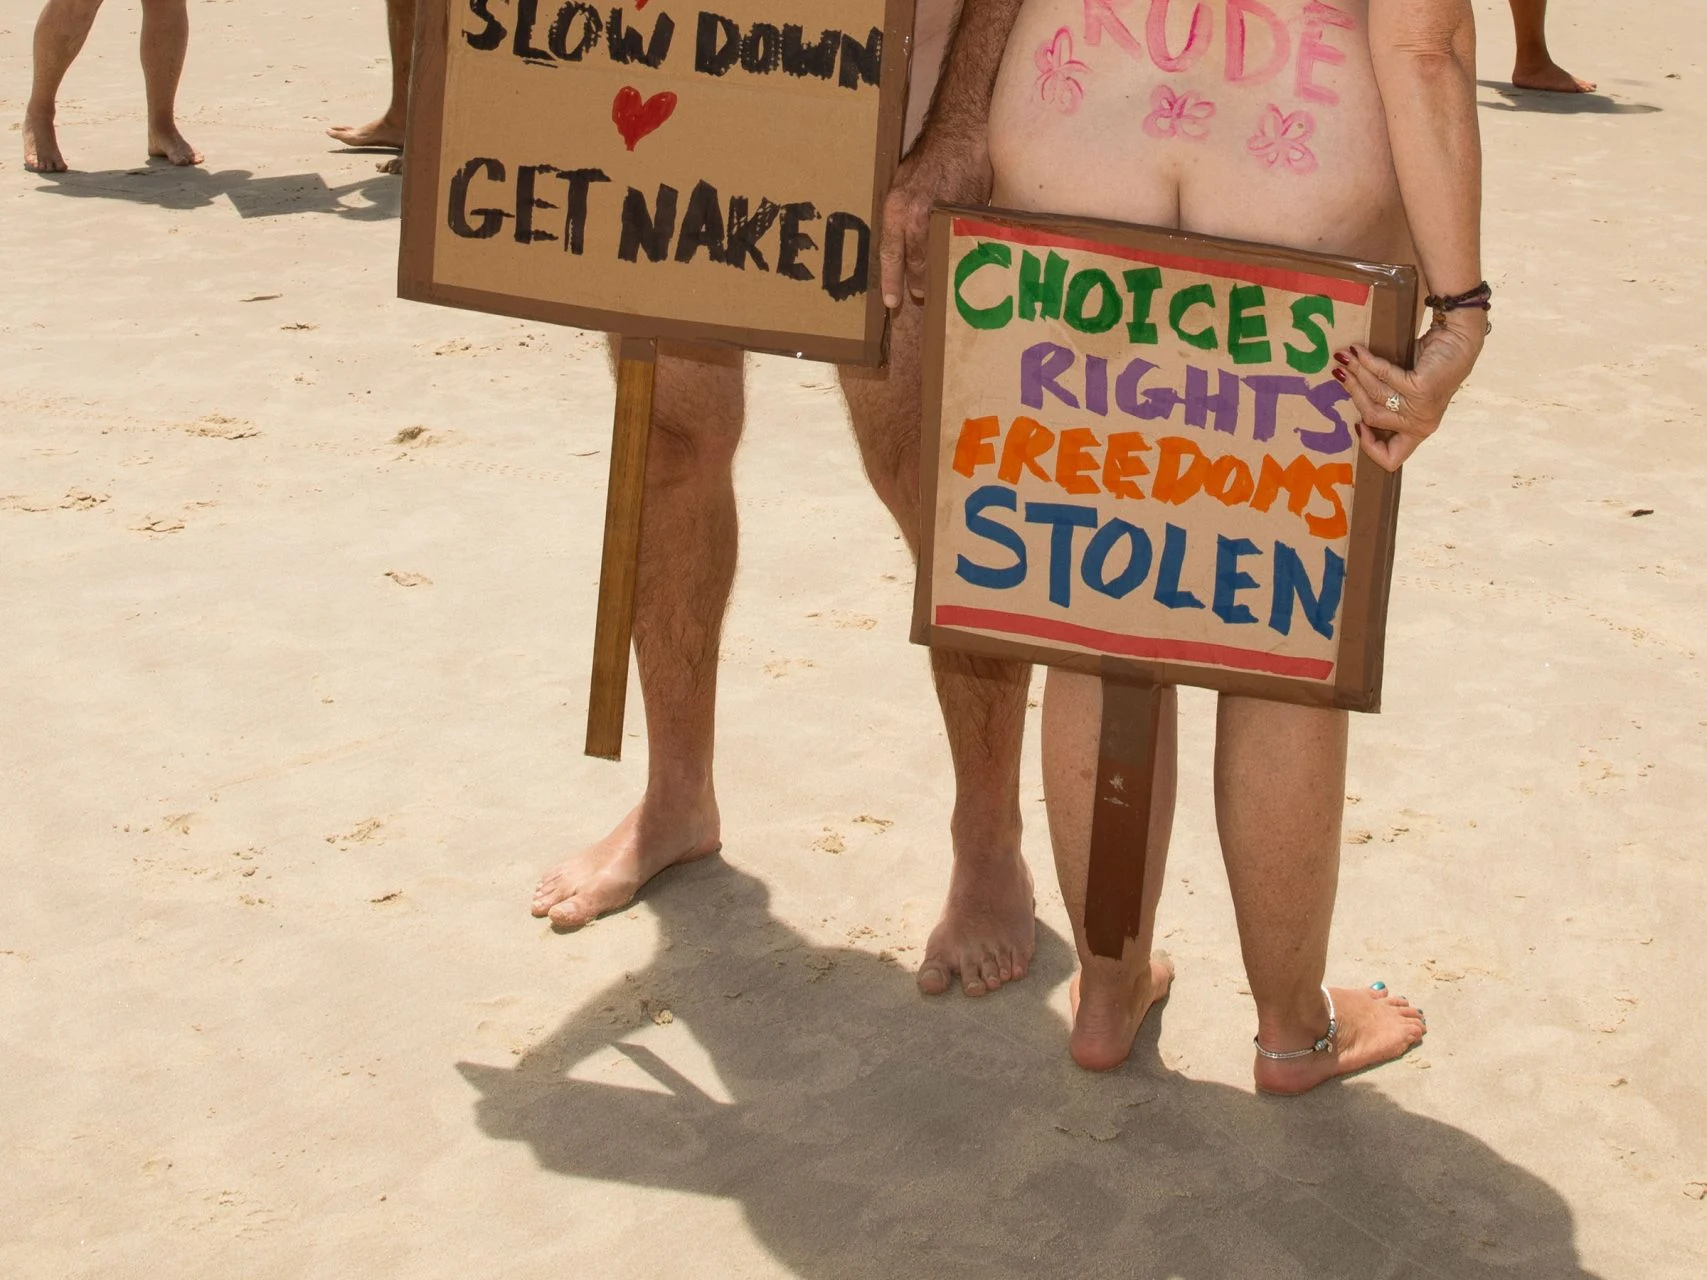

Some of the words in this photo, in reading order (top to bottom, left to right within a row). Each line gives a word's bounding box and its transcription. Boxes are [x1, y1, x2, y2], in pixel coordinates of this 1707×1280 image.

[695, 11, 884, 90] DOWN
[447, 157, 612, 255] GET
[618, 179, 871, 302] NAKED
[954, 242, 1335, 374] CHOICES
[1021, 342, 1354, 454] RIGHTS
[952, 416, 1354, 539] FREEDOMS
[954, 485, 1346, 640] STOLEN
